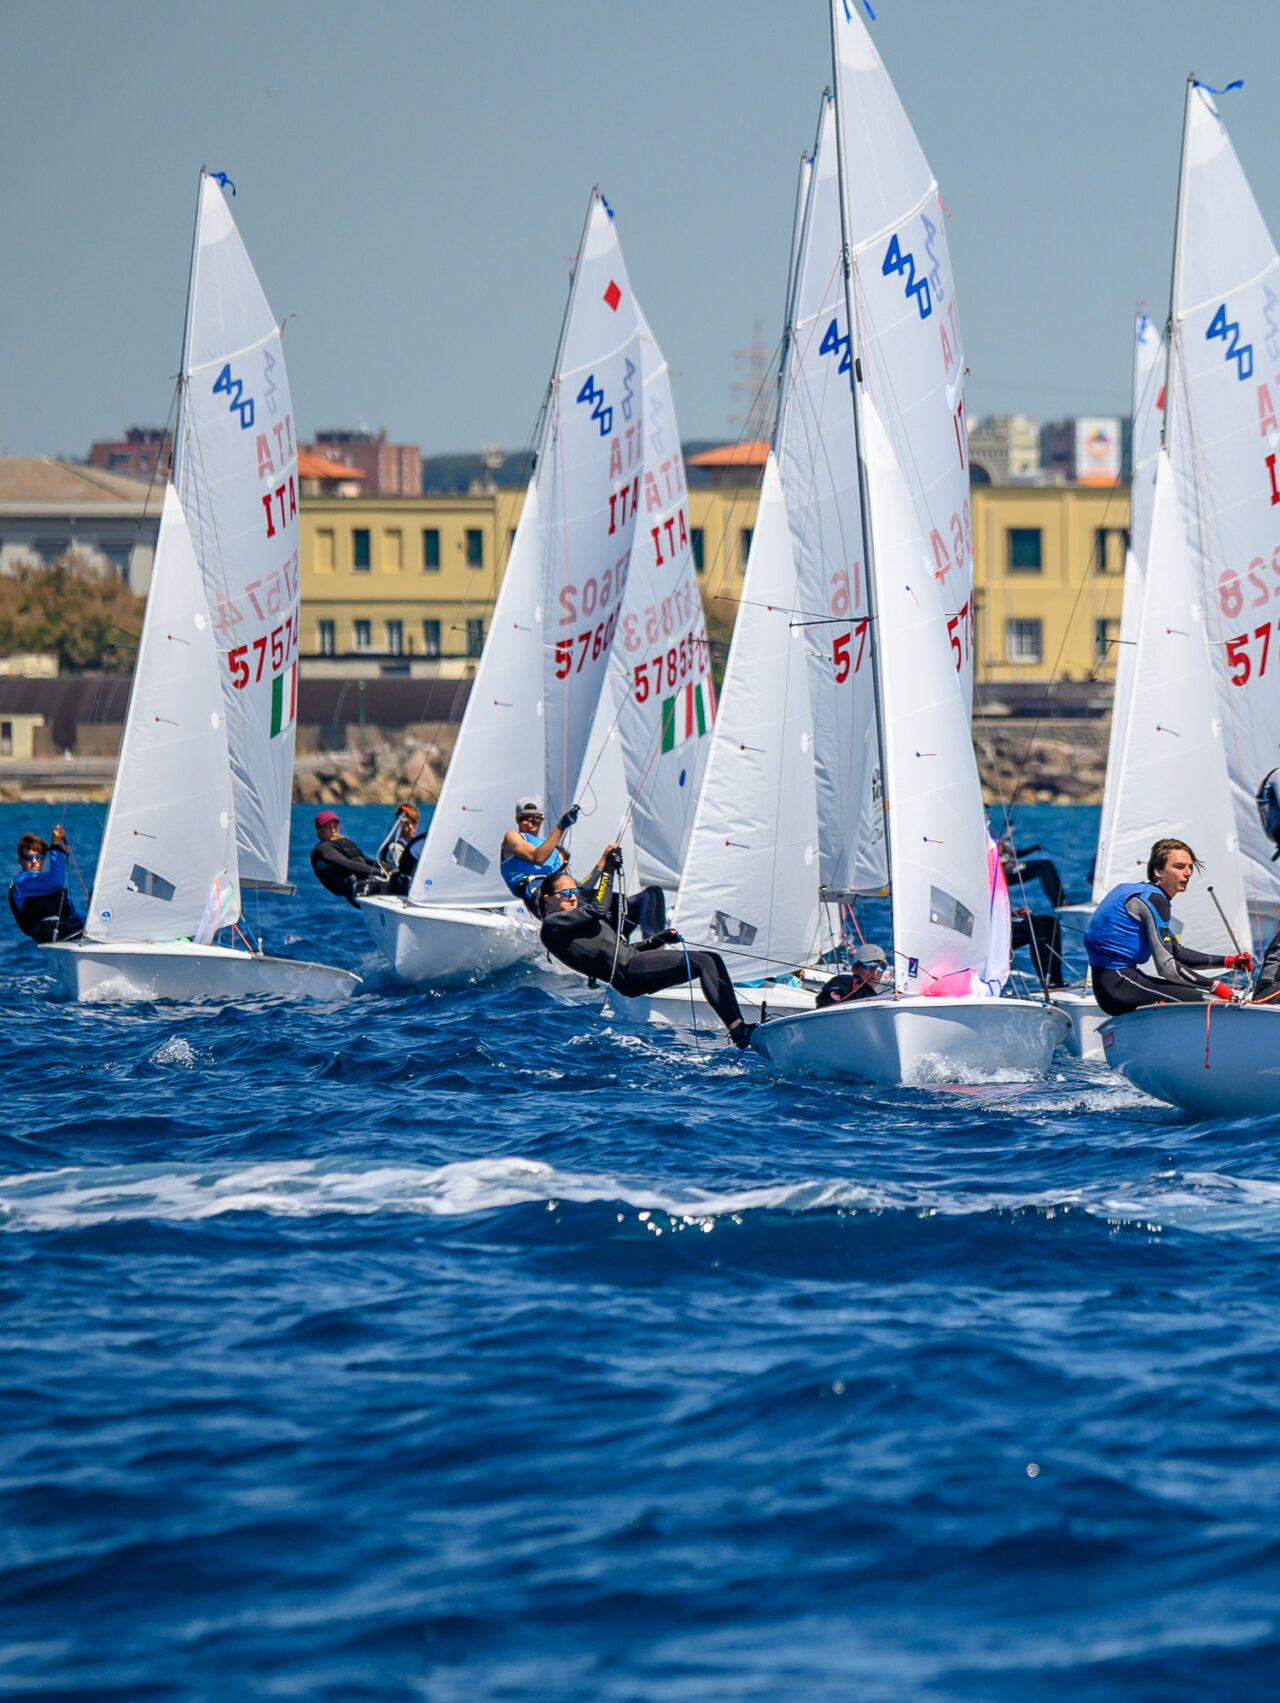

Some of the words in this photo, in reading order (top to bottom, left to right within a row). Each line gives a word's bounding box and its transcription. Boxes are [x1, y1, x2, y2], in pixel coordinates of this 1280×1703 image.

[882, 233, 932, 320] 420
[819, 318, 850, 375] 42
[1205, 303, 1253, 382] 420
[213, 363, 255, 429] 420
[576, 374, 613, 437] 420
[262, 475, 297, 538] ITA
[608, 476, 639, 535] ITA
[650, 509, 688, 567] ITA
[228, 606, 299, 689] 57574
[555, 600, 621, 680] 5760
